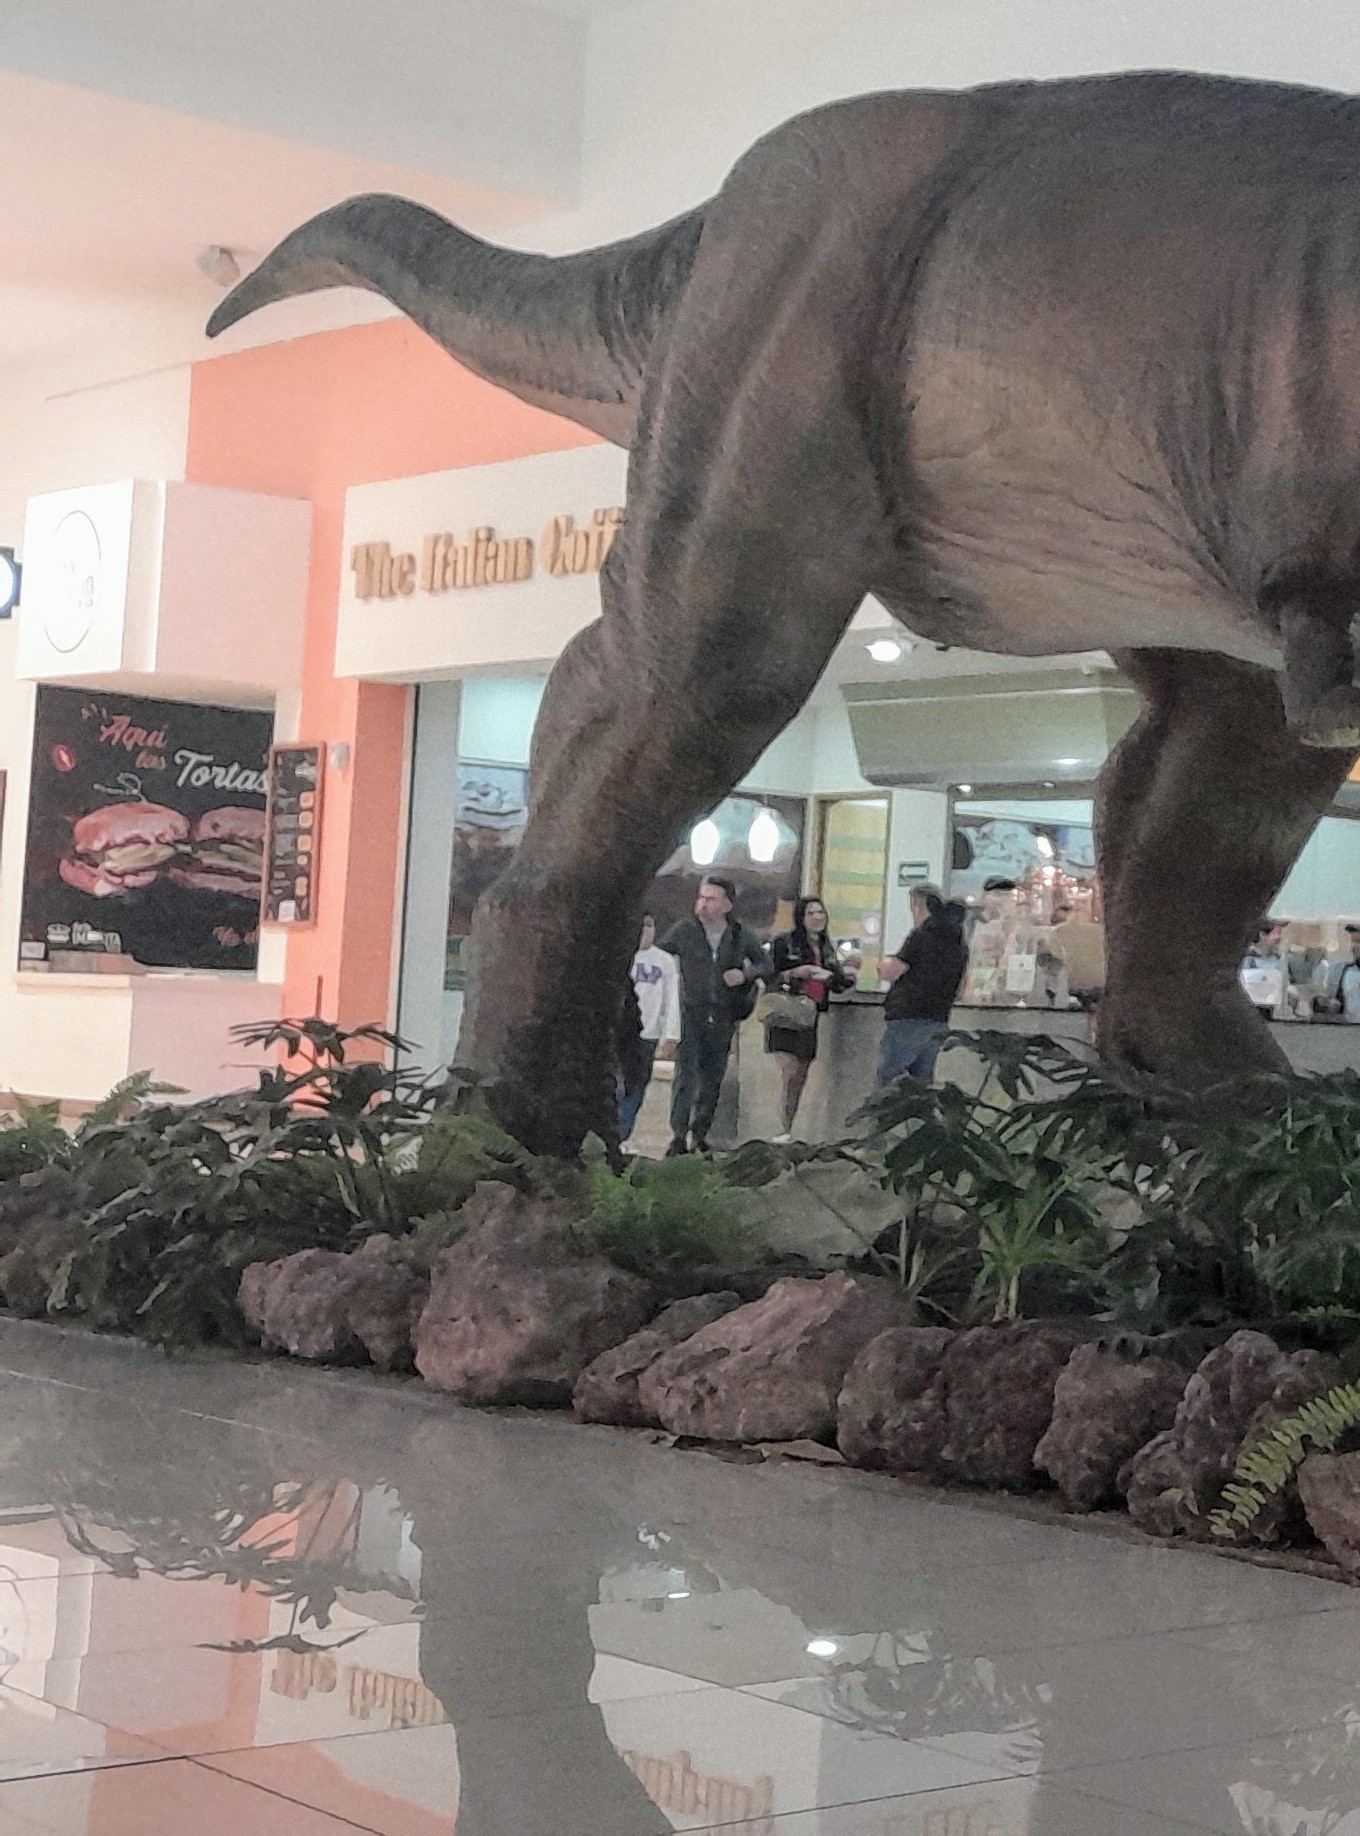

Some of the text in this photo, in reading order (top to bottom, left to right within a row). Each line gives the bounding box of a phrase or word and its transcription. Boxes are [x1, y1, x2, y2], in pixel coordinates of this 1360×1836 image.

[351, 540, 415, 600] The
[419, 526, 534, 595] Italian
[174, 749, 269, 795] Tortas
